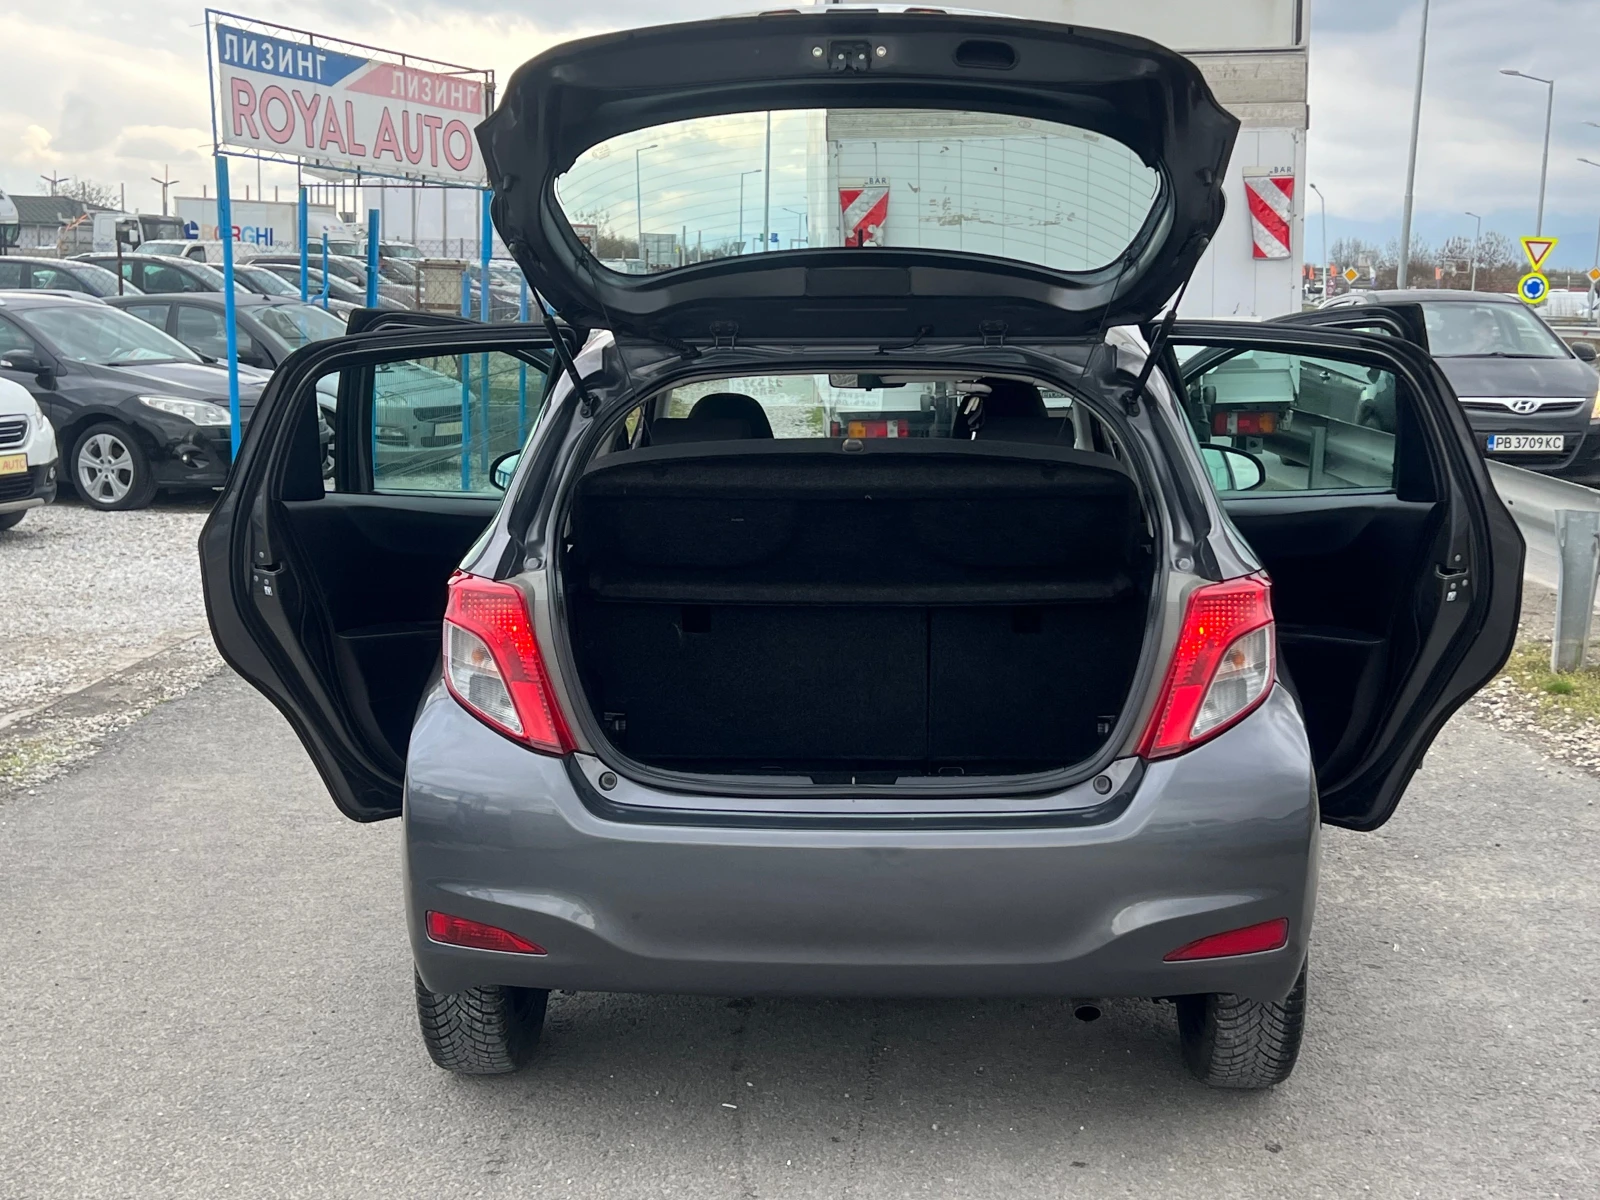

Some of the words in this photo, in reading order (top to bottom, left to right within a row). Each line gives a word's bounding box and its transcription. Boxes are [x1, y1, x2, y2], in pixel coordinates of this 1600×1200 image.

[224, 33, 326, 80] ЛИЗИНГ
[391, 71, 477, 109] ЛИЗИНГ
[231, 77, 366, 156] ROYAL
[373, 106, 472, 171] AUTO
[2, 458, 26, 470] AUTO
